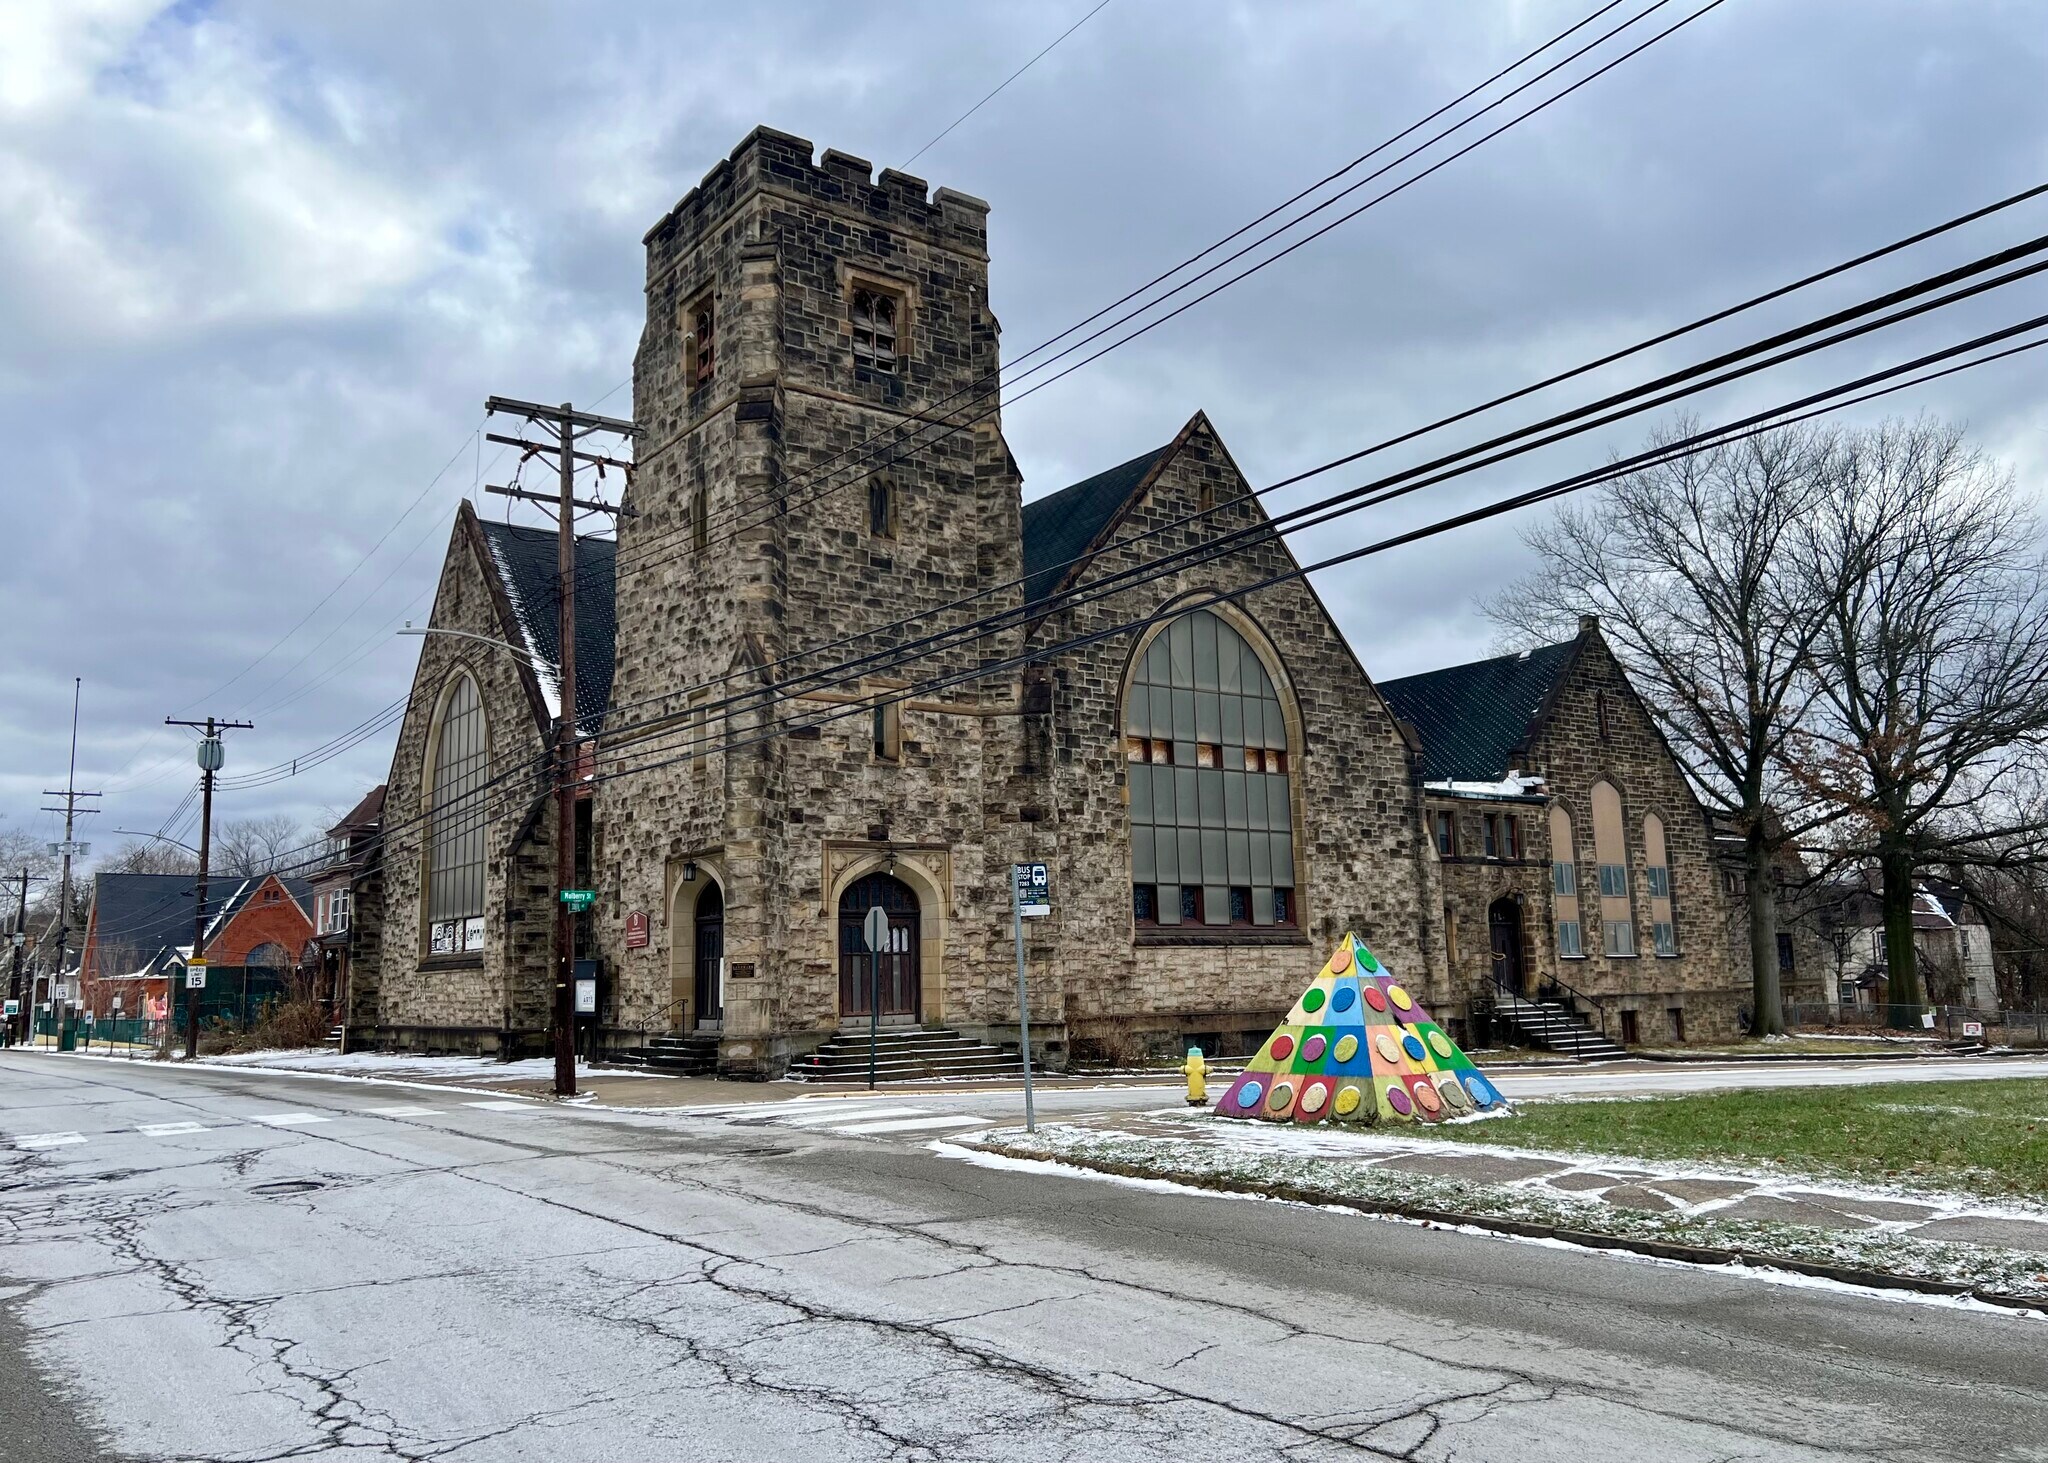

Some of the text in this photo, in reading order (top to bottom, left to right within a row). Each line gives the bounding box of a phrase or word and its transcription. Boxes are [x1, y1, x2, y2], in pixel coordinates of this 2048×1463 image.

[1017, 866, 1031, 874] BUS
[564, 892, 592, 901] Mulberry St
[191, 977, 202, 986] 15
